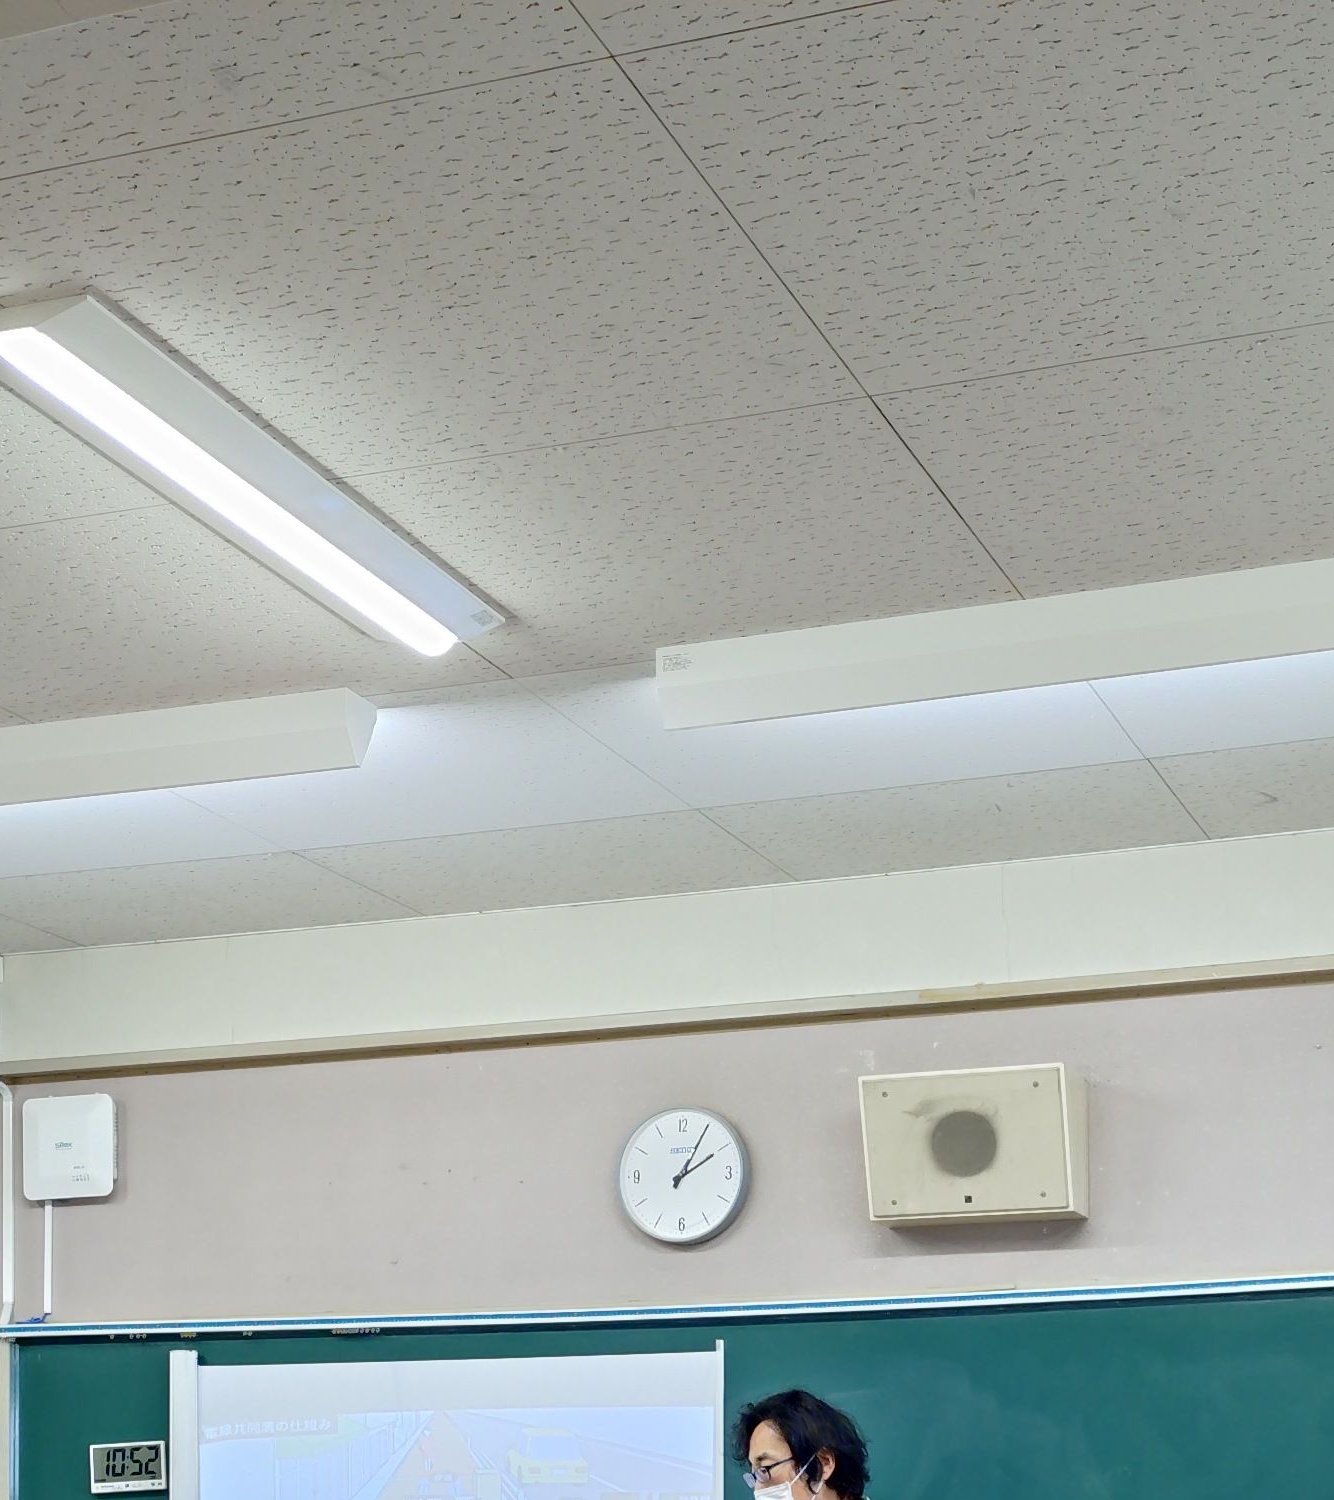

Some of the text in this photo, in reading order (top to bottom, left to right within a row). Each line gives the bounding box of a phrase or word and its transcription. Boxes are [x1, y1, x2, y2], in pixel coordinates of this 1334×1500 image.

[678, 1118, 688, 1133] 12
[633, 1166, 733, 1184] 9 3
[678, 1217, 686, 1231] 6
[105, 1446, 159, 1477] 10:52
